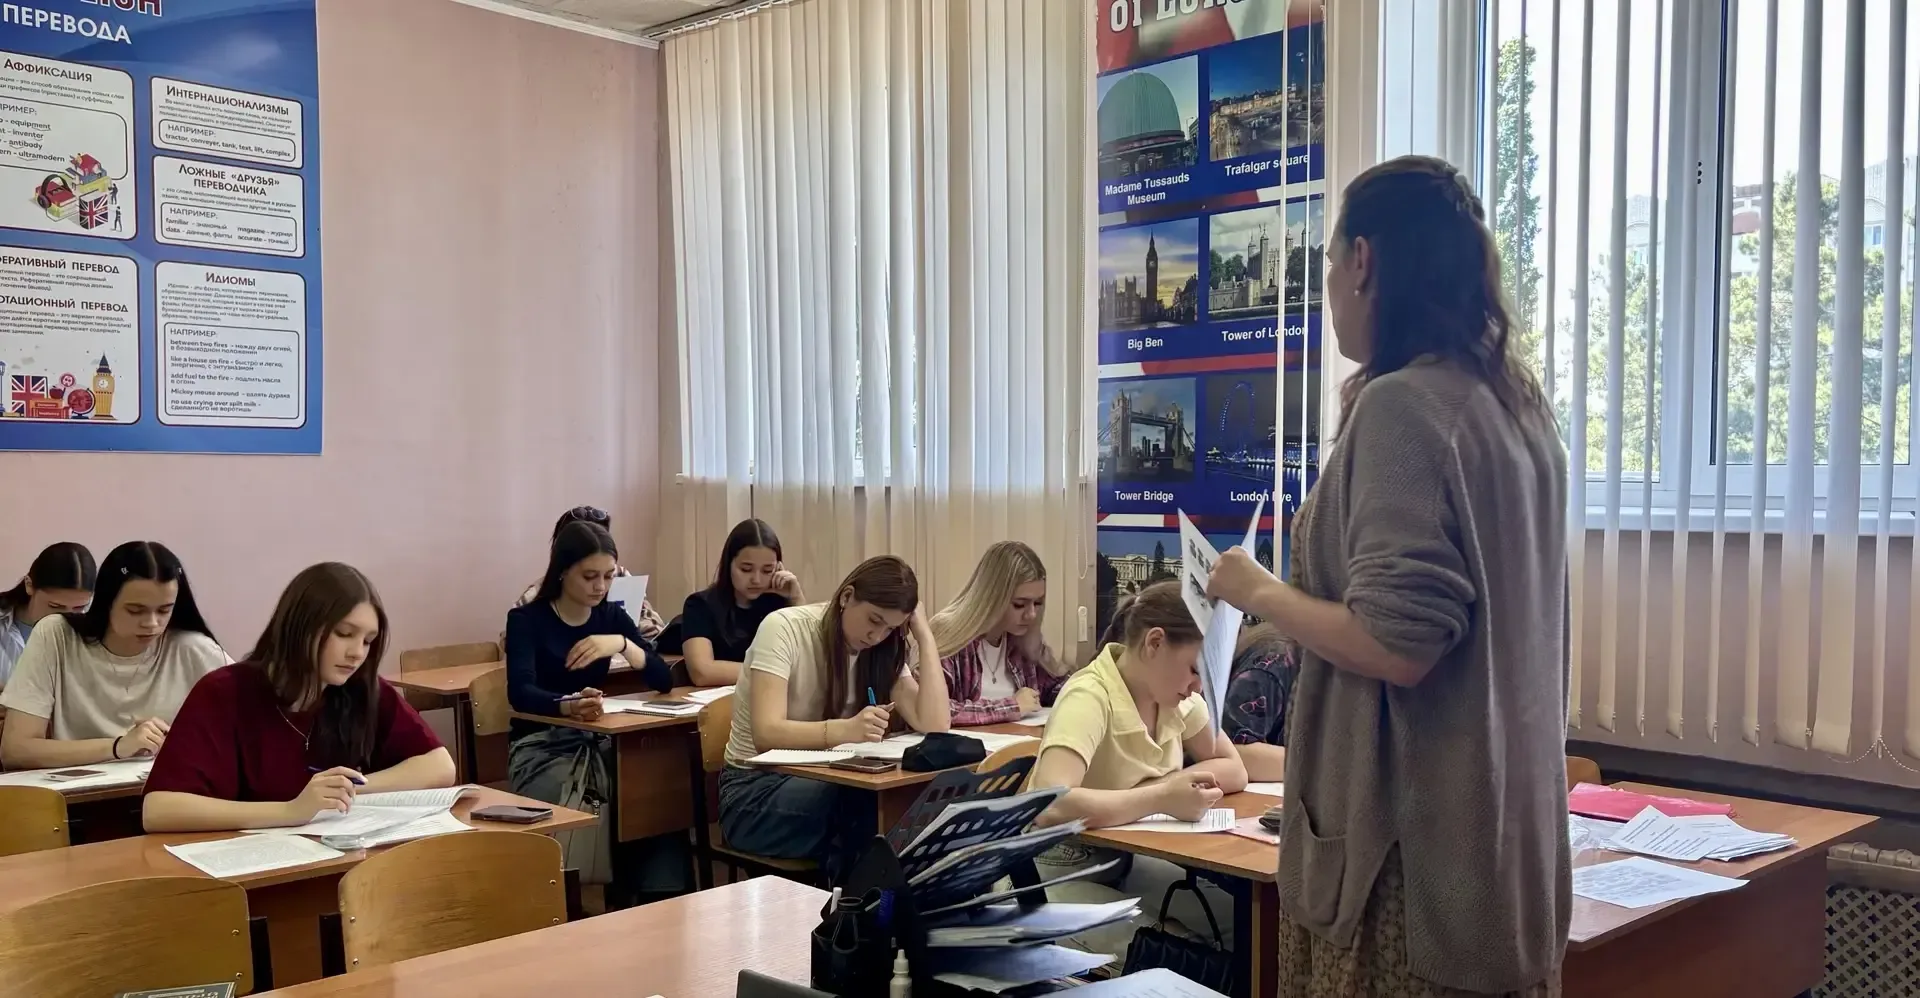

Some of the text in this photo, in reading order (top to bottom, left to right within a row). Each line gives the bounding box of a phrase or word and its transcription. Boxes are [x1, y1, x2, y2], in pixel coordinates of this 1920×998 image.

[3, 3, 132, 44] ПЕРЕВОДА
[4, 58, 92, 82] АФФИКСАЦИЯ
[166, 86, 288, 115] ИНТЕРНАЦИОНАЛИЗМЫ
[0, 103, 36, 115] РИМЕР:
[10, 118, 50, 131] equipment
[168, 123, 216, 137] НАПРИМЕР:
[12, 129, 43, 139] inventer
[9, 139, 42, 150] antibody
[165, 133, 189, 141] tractor,
[266, 149, 290, 157] complex
[18, 151, 64, 162] ultramodern
[1224, 154, 1309, 177] Trafalgar suare
[178, 165, 279, 186] ЛОЖНЫЕ «ДРУЗЬЯ»
[194, 178, 266, 196] ПЕРЕВОДЧИКА
[1105, 173, 1190, 196] Madame Tussauds
[1127, 191, 1166, 206] Museum
[0, 254, 119, 275] ЕРАТИВНЫЙ ПЕРЕВОД
[206, 272, 255, 287] ИДИОМЫ
[81, 300, 128, 313] ПЕРЕВОД
[1222, 330, 1252, 342] Tower
[1254, 327, 1266, 338] of
[1128, 337, 1163, 350] Big Ben
[1114, 490, 1174, 502] Tower Bridge
[1230, 490, 1269, 502] London
